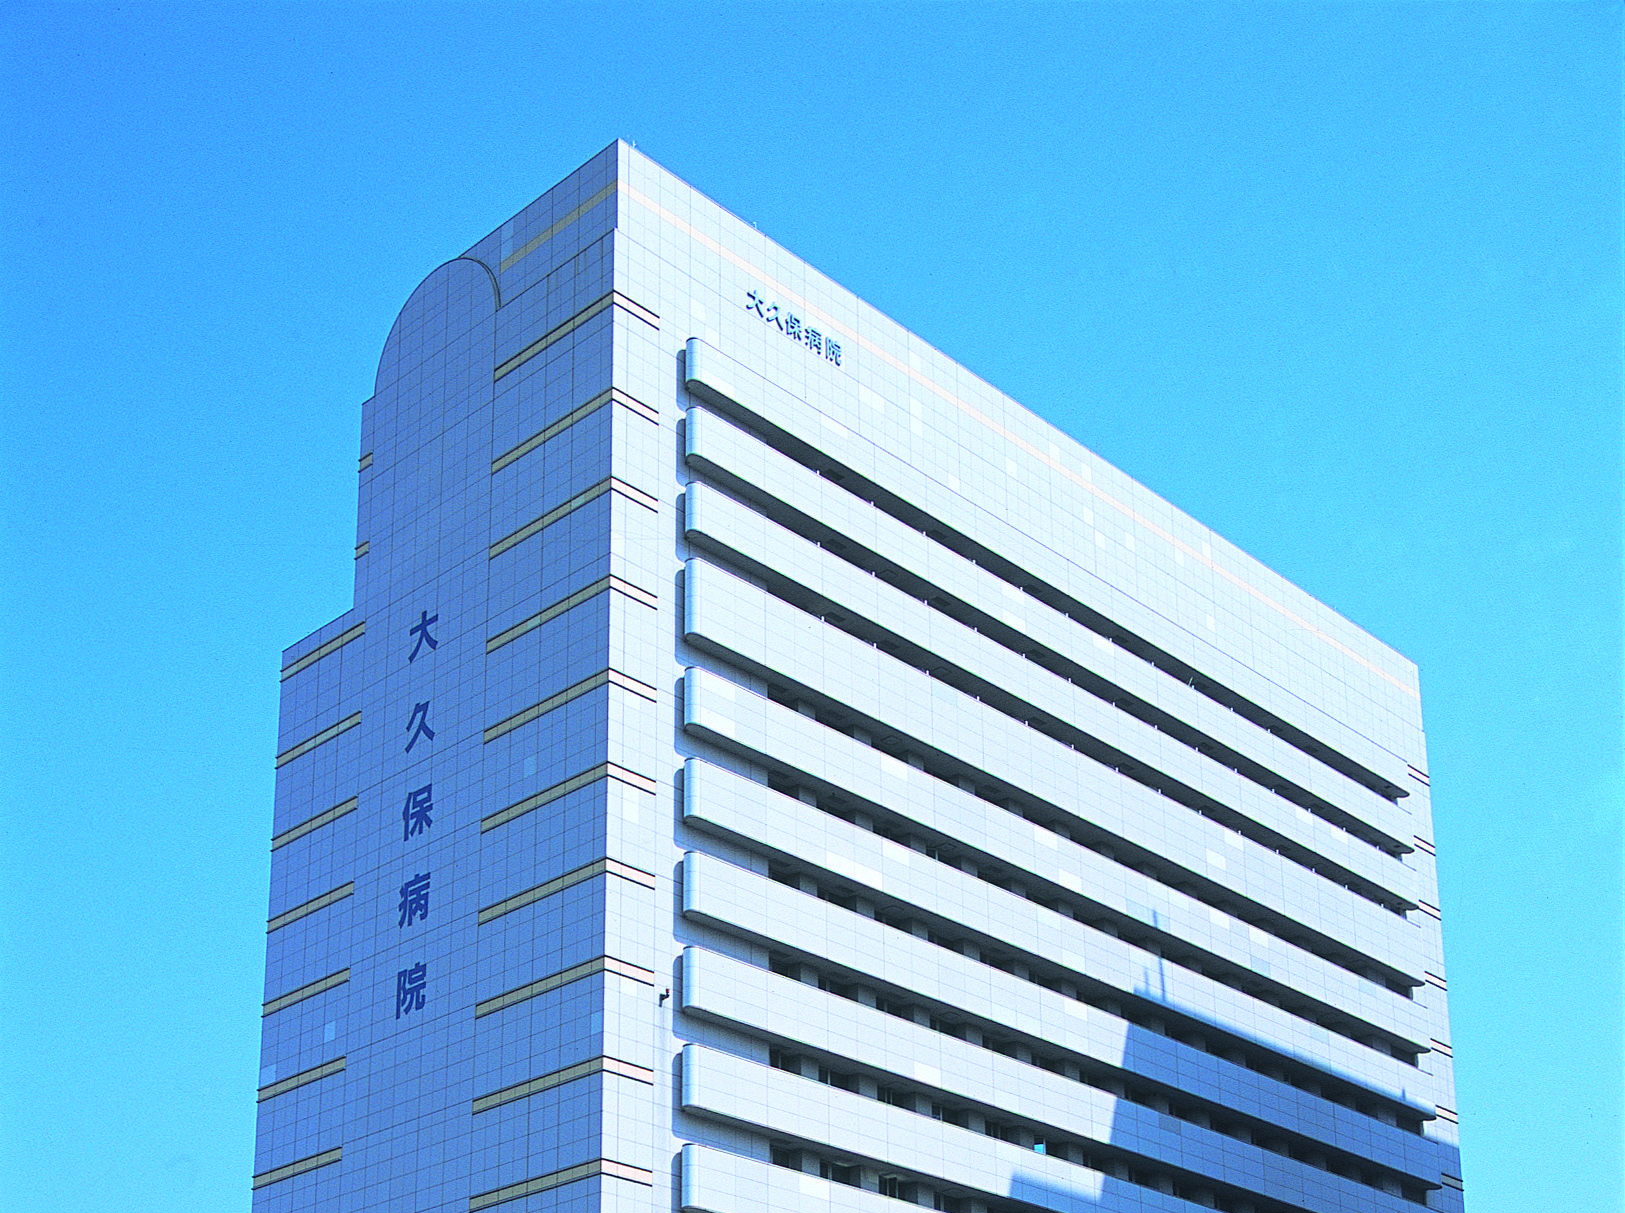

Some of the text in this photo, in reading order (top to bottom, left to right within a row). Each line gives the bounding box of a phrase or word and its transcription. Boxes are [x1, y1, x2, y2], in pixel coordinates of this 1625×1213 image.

[746, 289, 841, 367] 大久保病院
[395, 610, 439, 1020] 大久保病院
